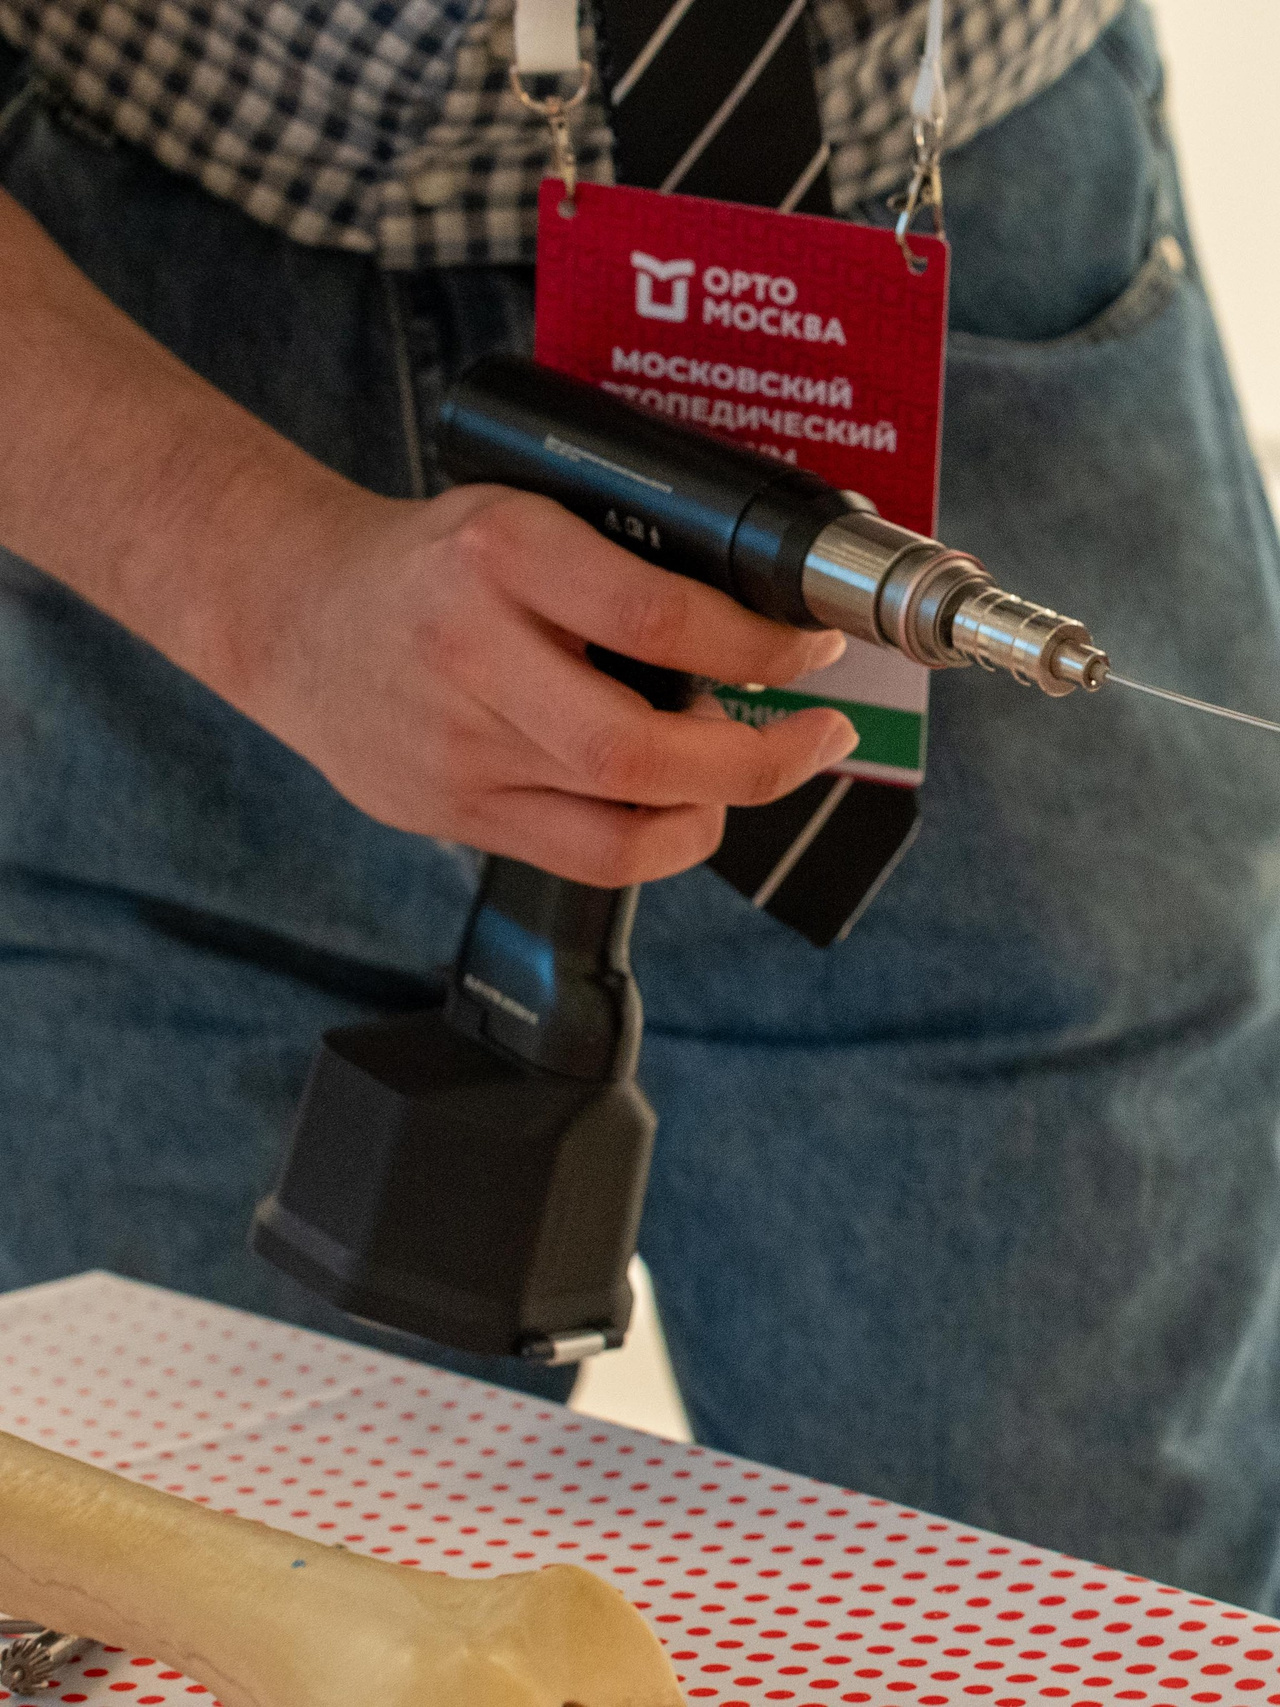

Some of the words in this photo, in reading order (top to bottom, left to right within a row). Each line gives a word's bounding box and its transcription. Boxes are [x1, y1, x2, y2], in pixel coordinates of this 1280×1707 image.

[702, 267, 798, 305] ОРТО
[702, 299, 848, 346] МОСКВА
[611, 346, 854, 410] МОСКОВСКИЙ
